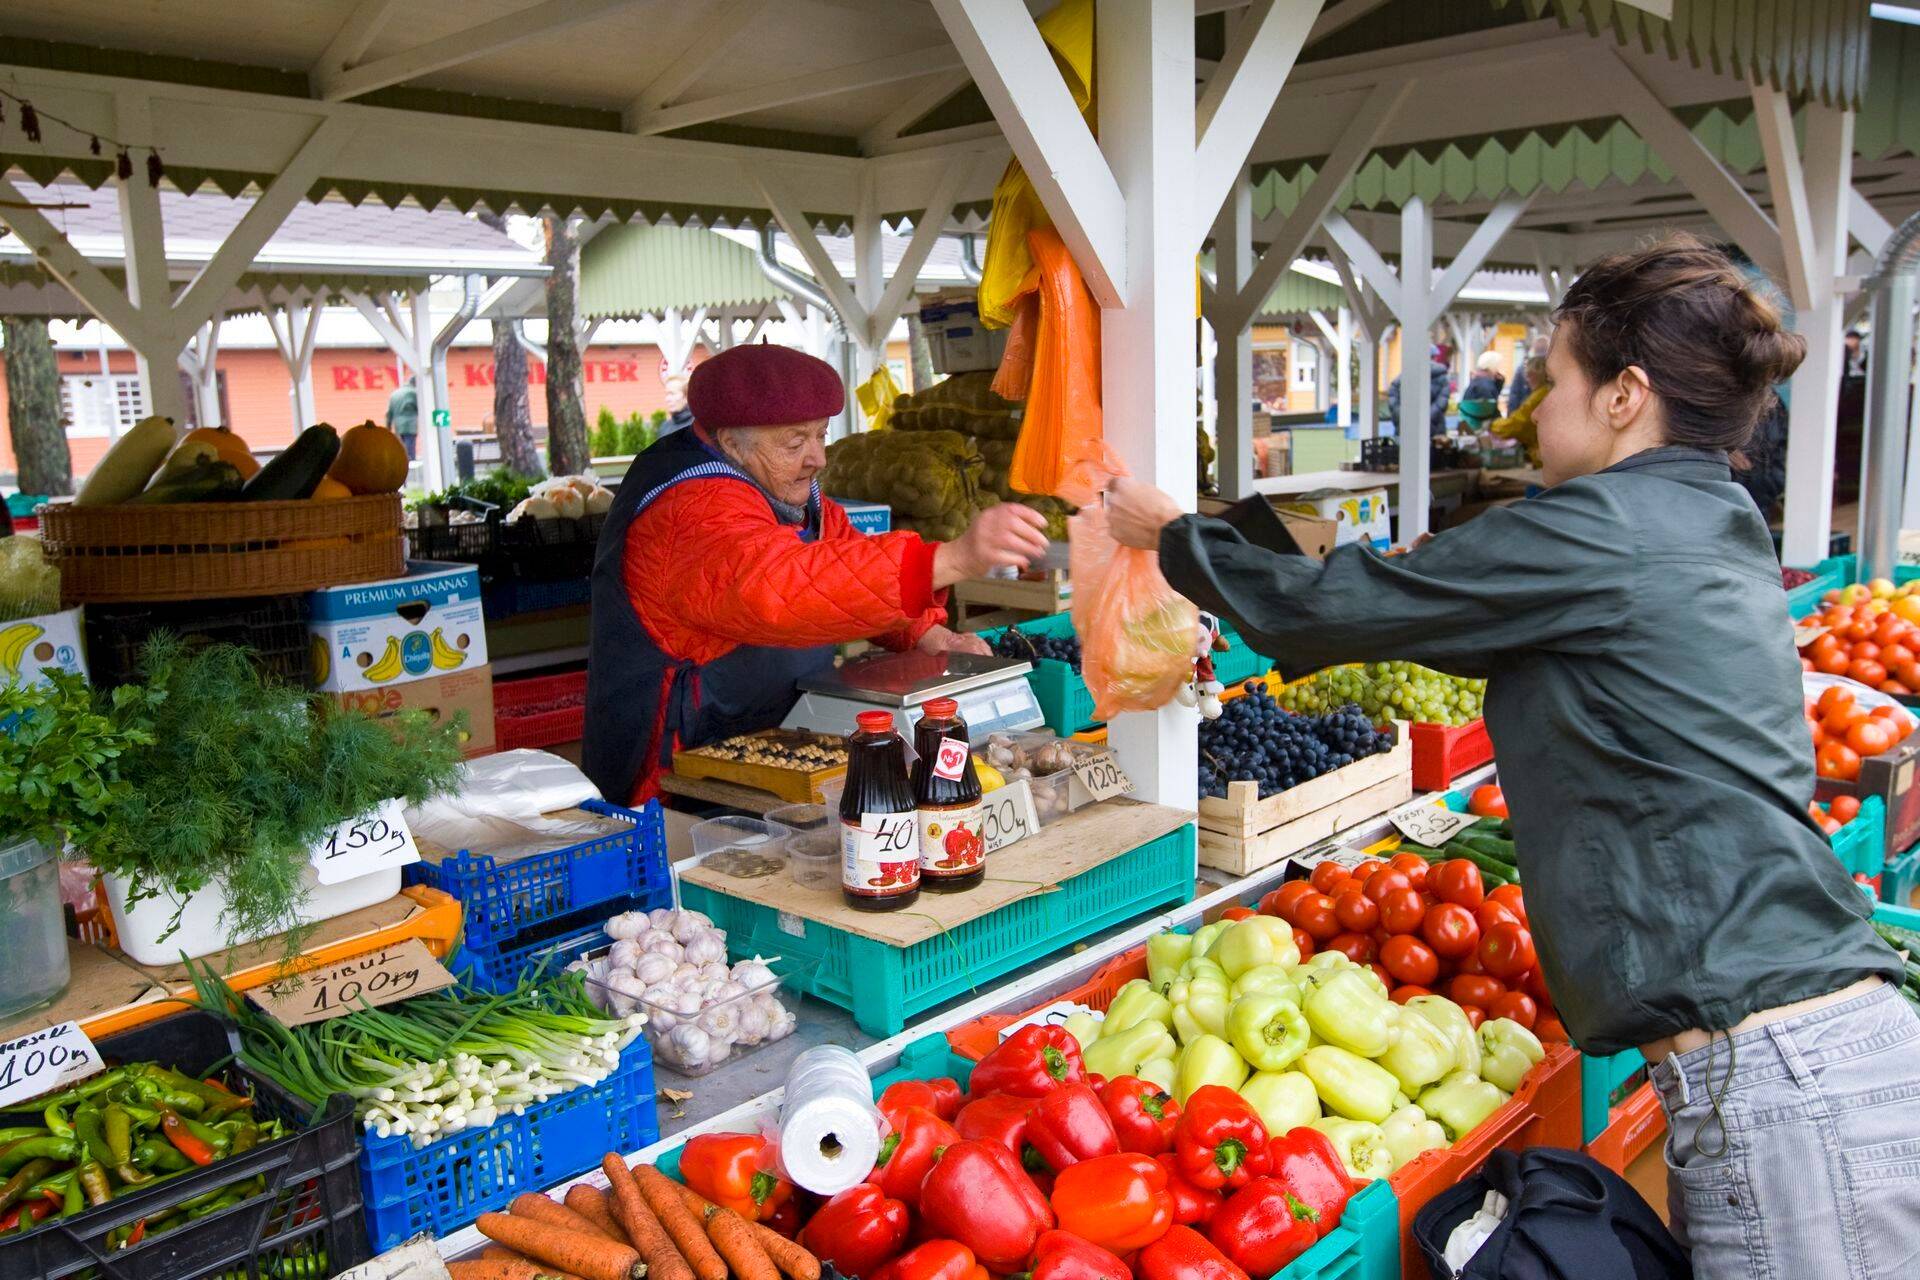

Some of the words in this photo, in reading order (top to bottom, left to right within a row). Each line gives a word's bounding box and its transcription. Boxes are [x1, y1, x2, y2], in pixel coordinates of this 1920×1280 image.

[345, 587, 406, 606] PREMIUM
[411, 576, 468, 597] BANANAS
[342, 645, 351, 659] A
[874, 818, 913, 852] 40
